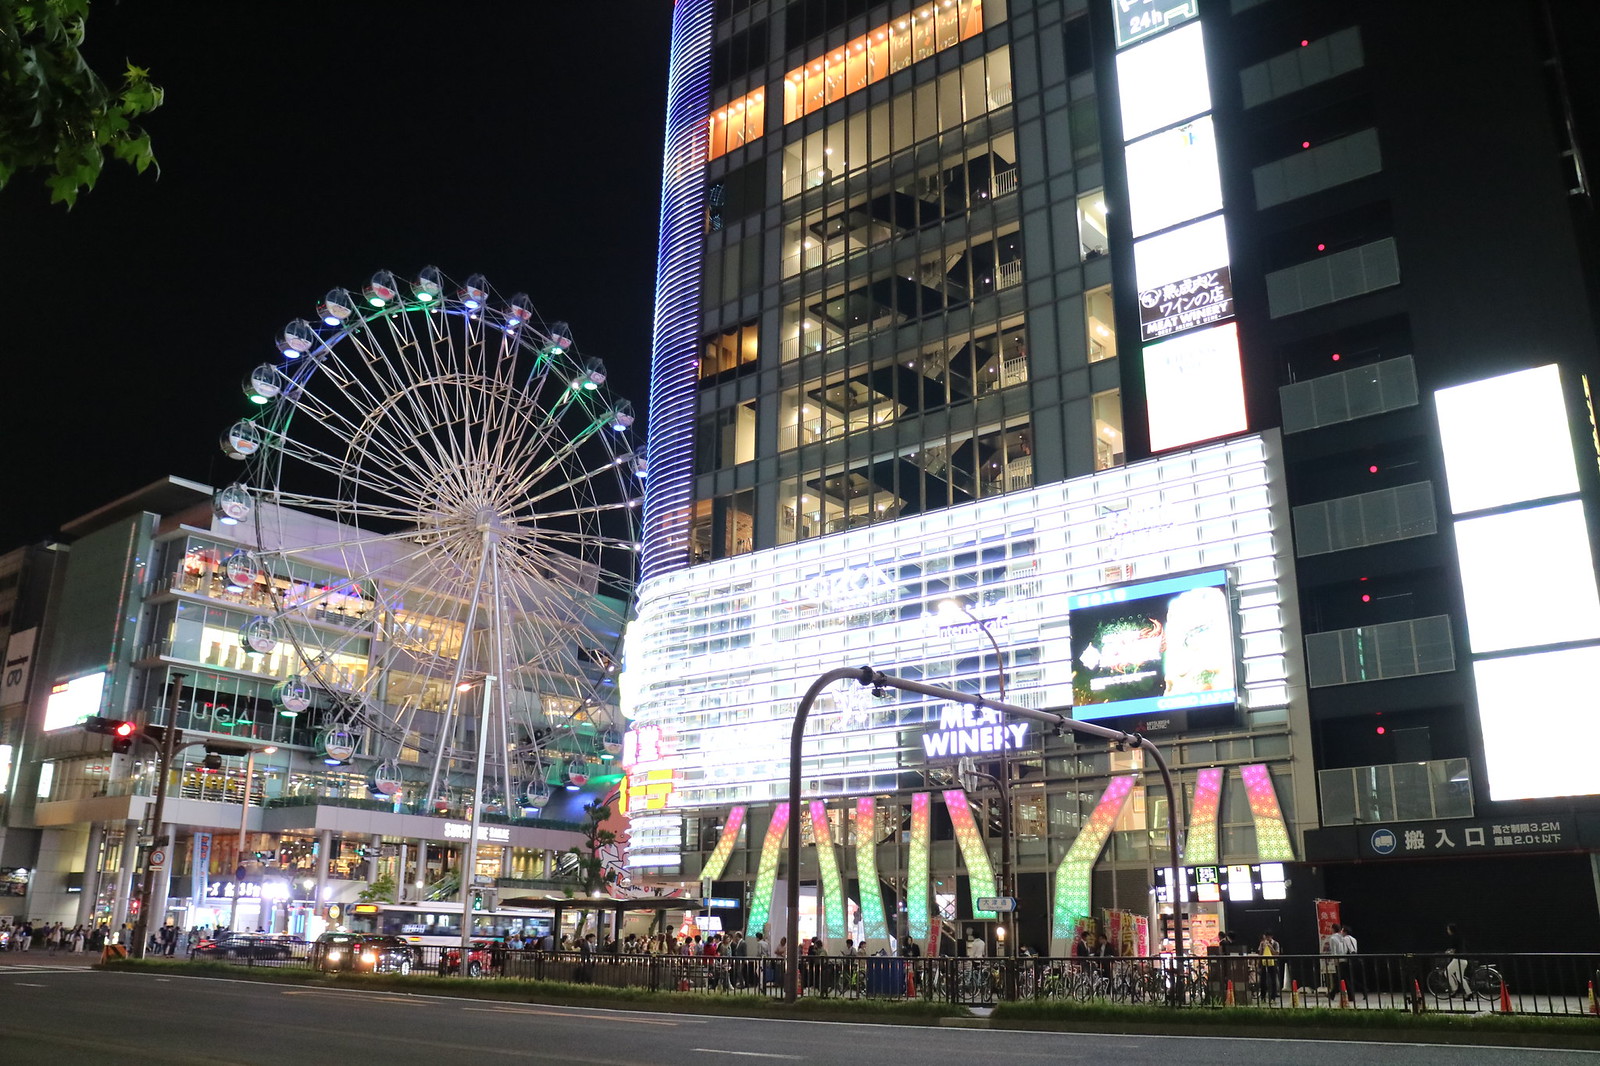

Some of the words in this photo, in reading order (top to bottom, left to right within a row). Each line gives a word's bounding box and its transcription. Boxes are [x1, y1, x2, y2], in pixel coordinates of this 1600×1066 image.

[1129, 9, 1162, 34] 24h
[1159, 286, 1224, 317] ワインの店
[1147, 315, 1180, 334] MEAT
[1180, 300, 1228, 323] WINERY
[922, 722, 1029, 757] WINERY
[1404, 827, 1485, 850] 搬入口
[1492, 822, 1561, 835] 高さ制限3.2M
[1493, 834, 1562, 847] 重量2.0t以下
